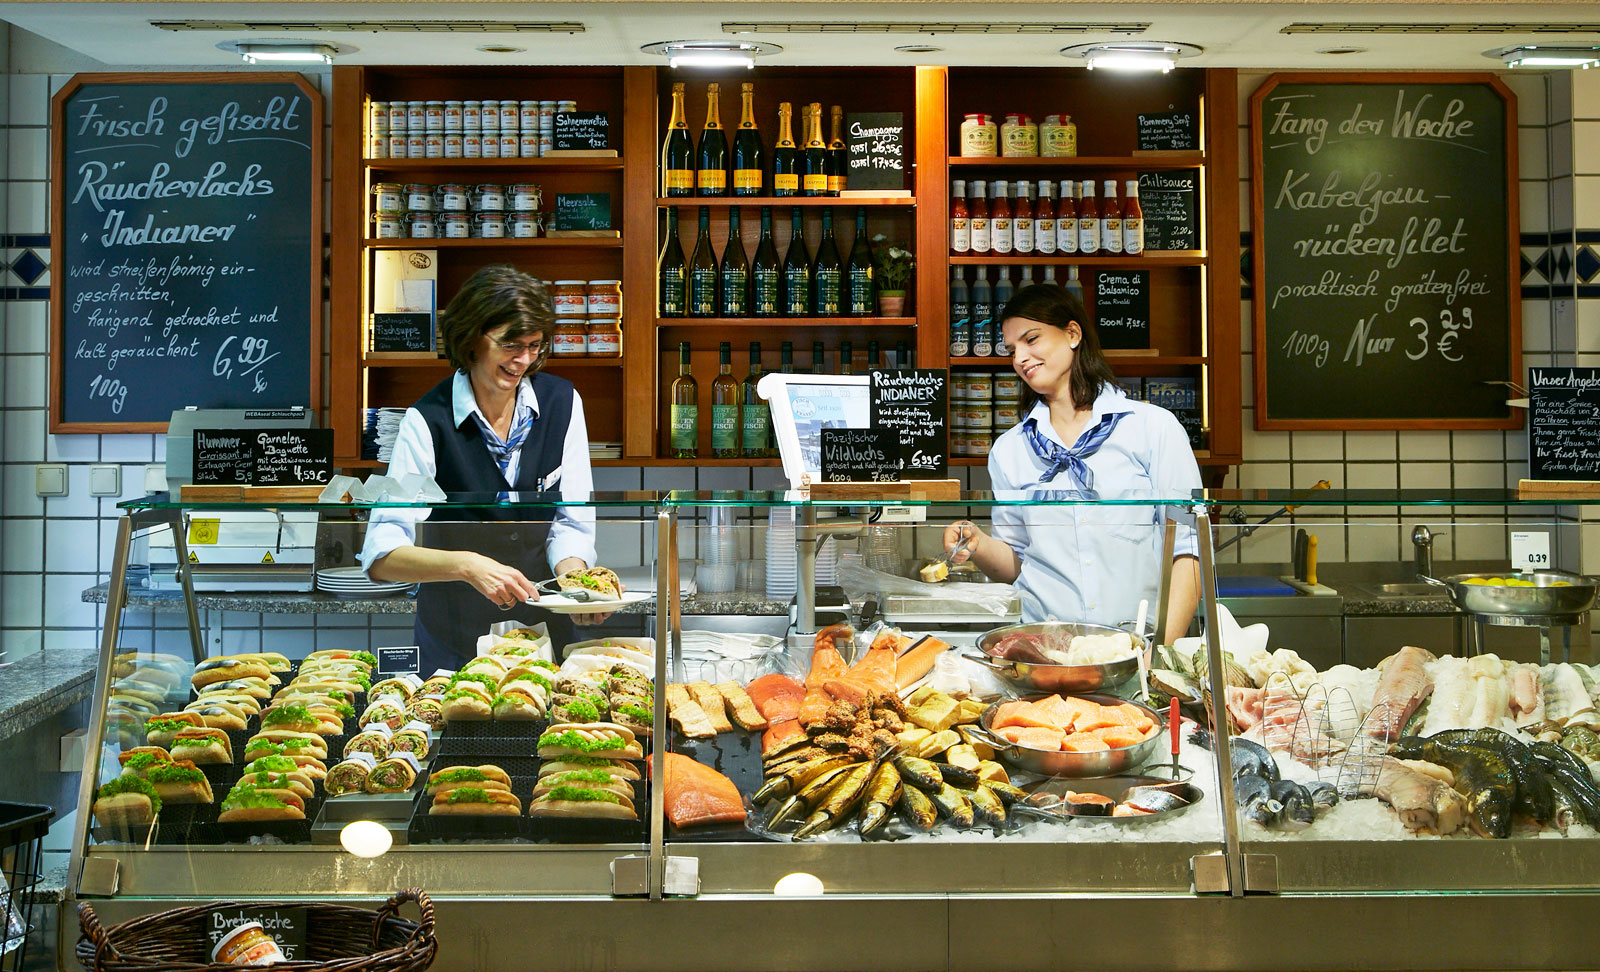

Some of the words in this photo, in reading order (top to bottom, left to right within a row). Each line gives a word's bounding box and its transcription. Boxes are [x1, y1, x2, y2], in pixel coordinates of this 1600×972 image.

[77, 96, 168, 136] Frisch
[175, 96, 300, 158] gefischt
[1270, 95, 1328, 155] Fang
[1338, 103, 1384, 135] der
[1391, 89, 1474, 139] Woche
[850, 121, 903, 142] Champagner
[72, 161, 274, 212] Räucherlachs
[1139, 173, 1194, 189] Chilisauce
[1294, 216, 1468, 269] rückenfilet
[70, 259, 104, 277] wird
[108, 255, 215, 287] streifenförmig
[1098, 273, 1129, 285] Crema
[1132, 273, 1141, 284] di
[1098, 284, 1139, 296] Balsamico
[1272, 269, 1380, 309] praktisch
[1385, 268, 1491, 313] grätenfrei
[88, 307, 153, 337] hängend
[163, 306, 241, 337] getrocknet
[249, 306, 279, 324] und
[1282, 330, 1330, 368] 100g
[1343, 313, 1396, 367] Nur
[74, 339, 107, 359] kalt
[108, 334, 201, 370] geräuchert
[873, 370, 944, 388] Räucherlachs
[1532, 369, 1566, 387] Unser
[89, 374, 128, 414] 100g
[824, 430, 879, 445] Pazifischer
[198, 449, 241, 460] Croissant
[264, 444, 309, 457] Baguette
[825, 444, 885, 461] Wildlachs
[1537, 447, 1551, 458] Ihr
[1552, 447, 1579, 459] Fisch
[257, 456, 269, 464] mit
[197, 470, 219, 481] Stück
[258, 474, 279, 482] Stück
